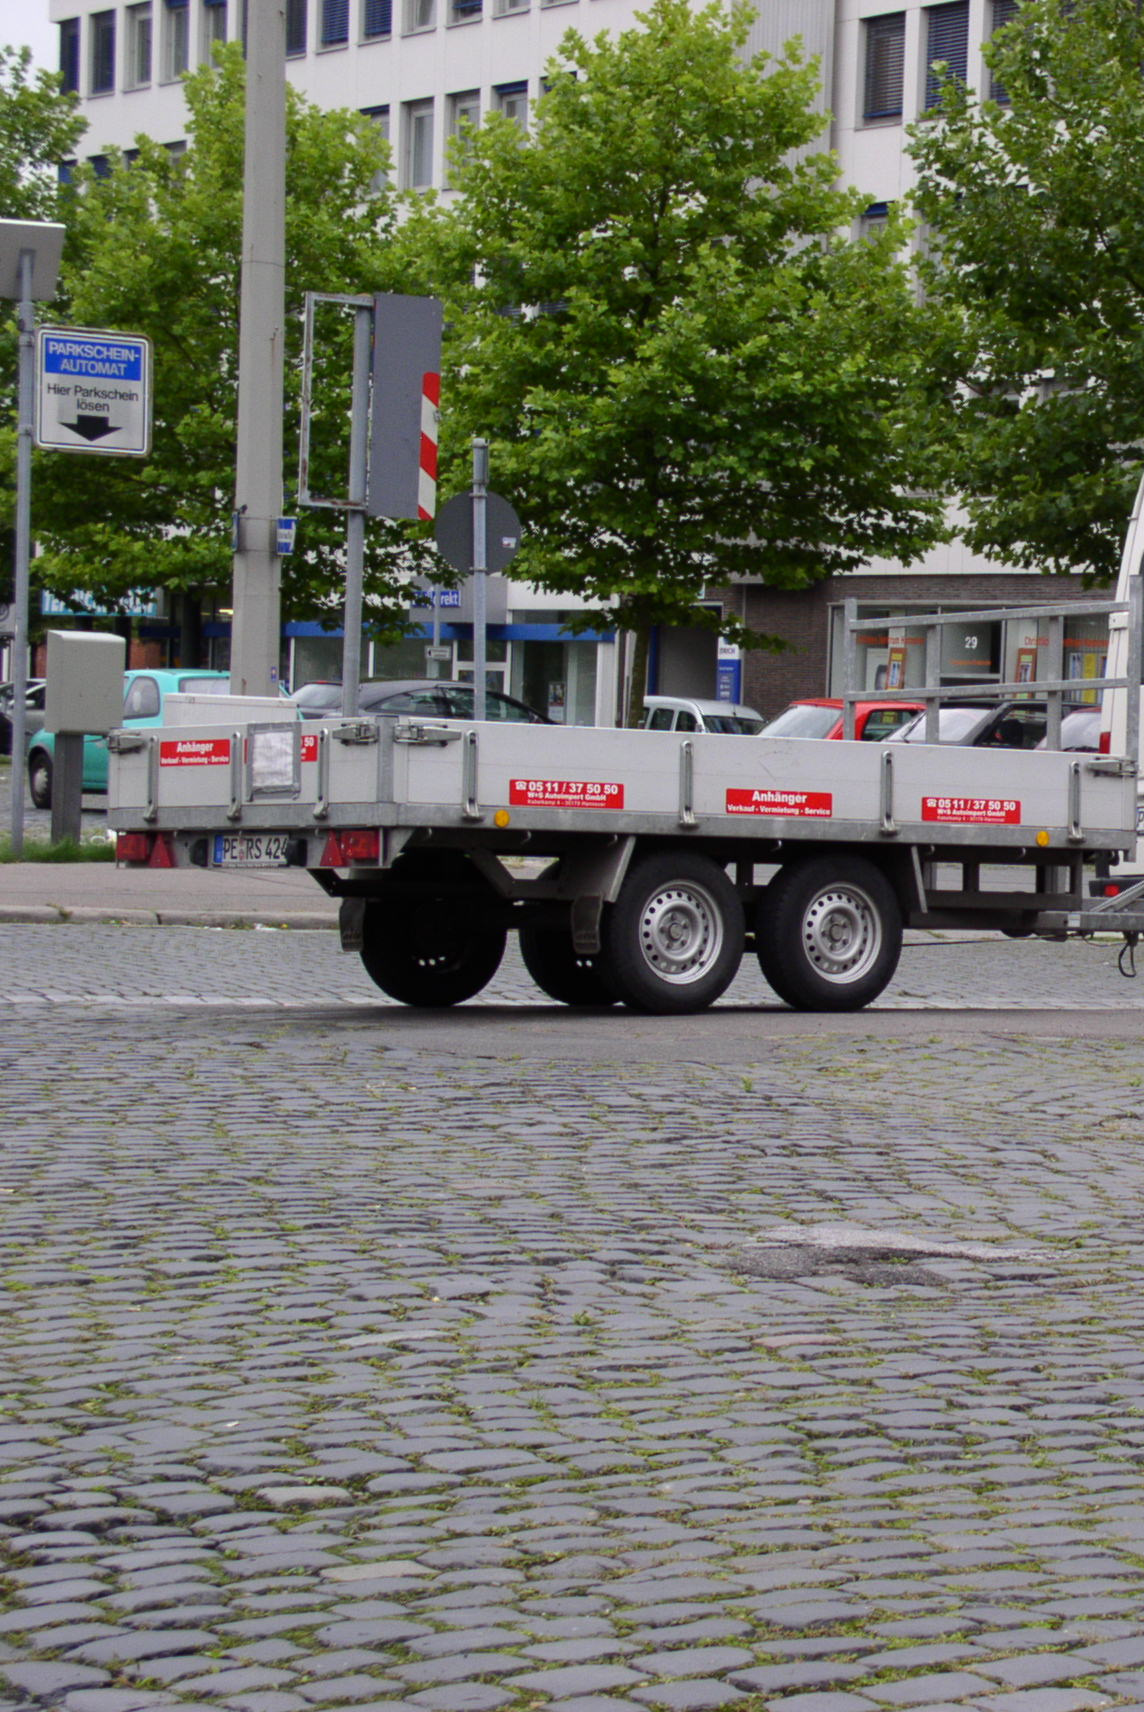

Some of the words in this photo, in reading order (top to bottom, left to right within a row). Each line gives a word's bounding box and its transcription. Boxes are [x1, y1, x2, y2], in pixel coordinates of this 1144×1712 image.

[48, 341, 140, 362] PARKSCHEIN-
[60, 359, 127, 376] AUTOMAT
[47, 383, 71, 396] Hier
[74, 385, 139, 401] Parkschein
[76, 398, 110, 412] lösen
[964, 636, 978, 649] 29
[176, 742, 214, 754] Anhänger
[304, 737, 314, 746] 50
[528, 781, 544, 791] 05
[545, 782, 559, 792] 11
[569, 783, 583, 793] 37
[586, 784, 601, 793] 50
[604, 784, 618, 795] 50
[545, 792, 584, 800] Autoimport
[585, 793, 607, 801] GmbH
[752, 790, 807, 805] Anhänger
[727, 804, 755, 812] Verkauf
[760, 805, 799, 815] Vermietung
[804, 807, 831, 815] Service
[938, 799, 951, 808] 05
[953, 800, 964, 808] 11
[973, 801, 986, 809] 37
[988, 801, 1001, 810] 50
[1003, 802, 1016, 810] 50
[224, 838, 238, 859] PE
[246, 838, 262, 859] RS
[265, 838, 288, 859] 424
